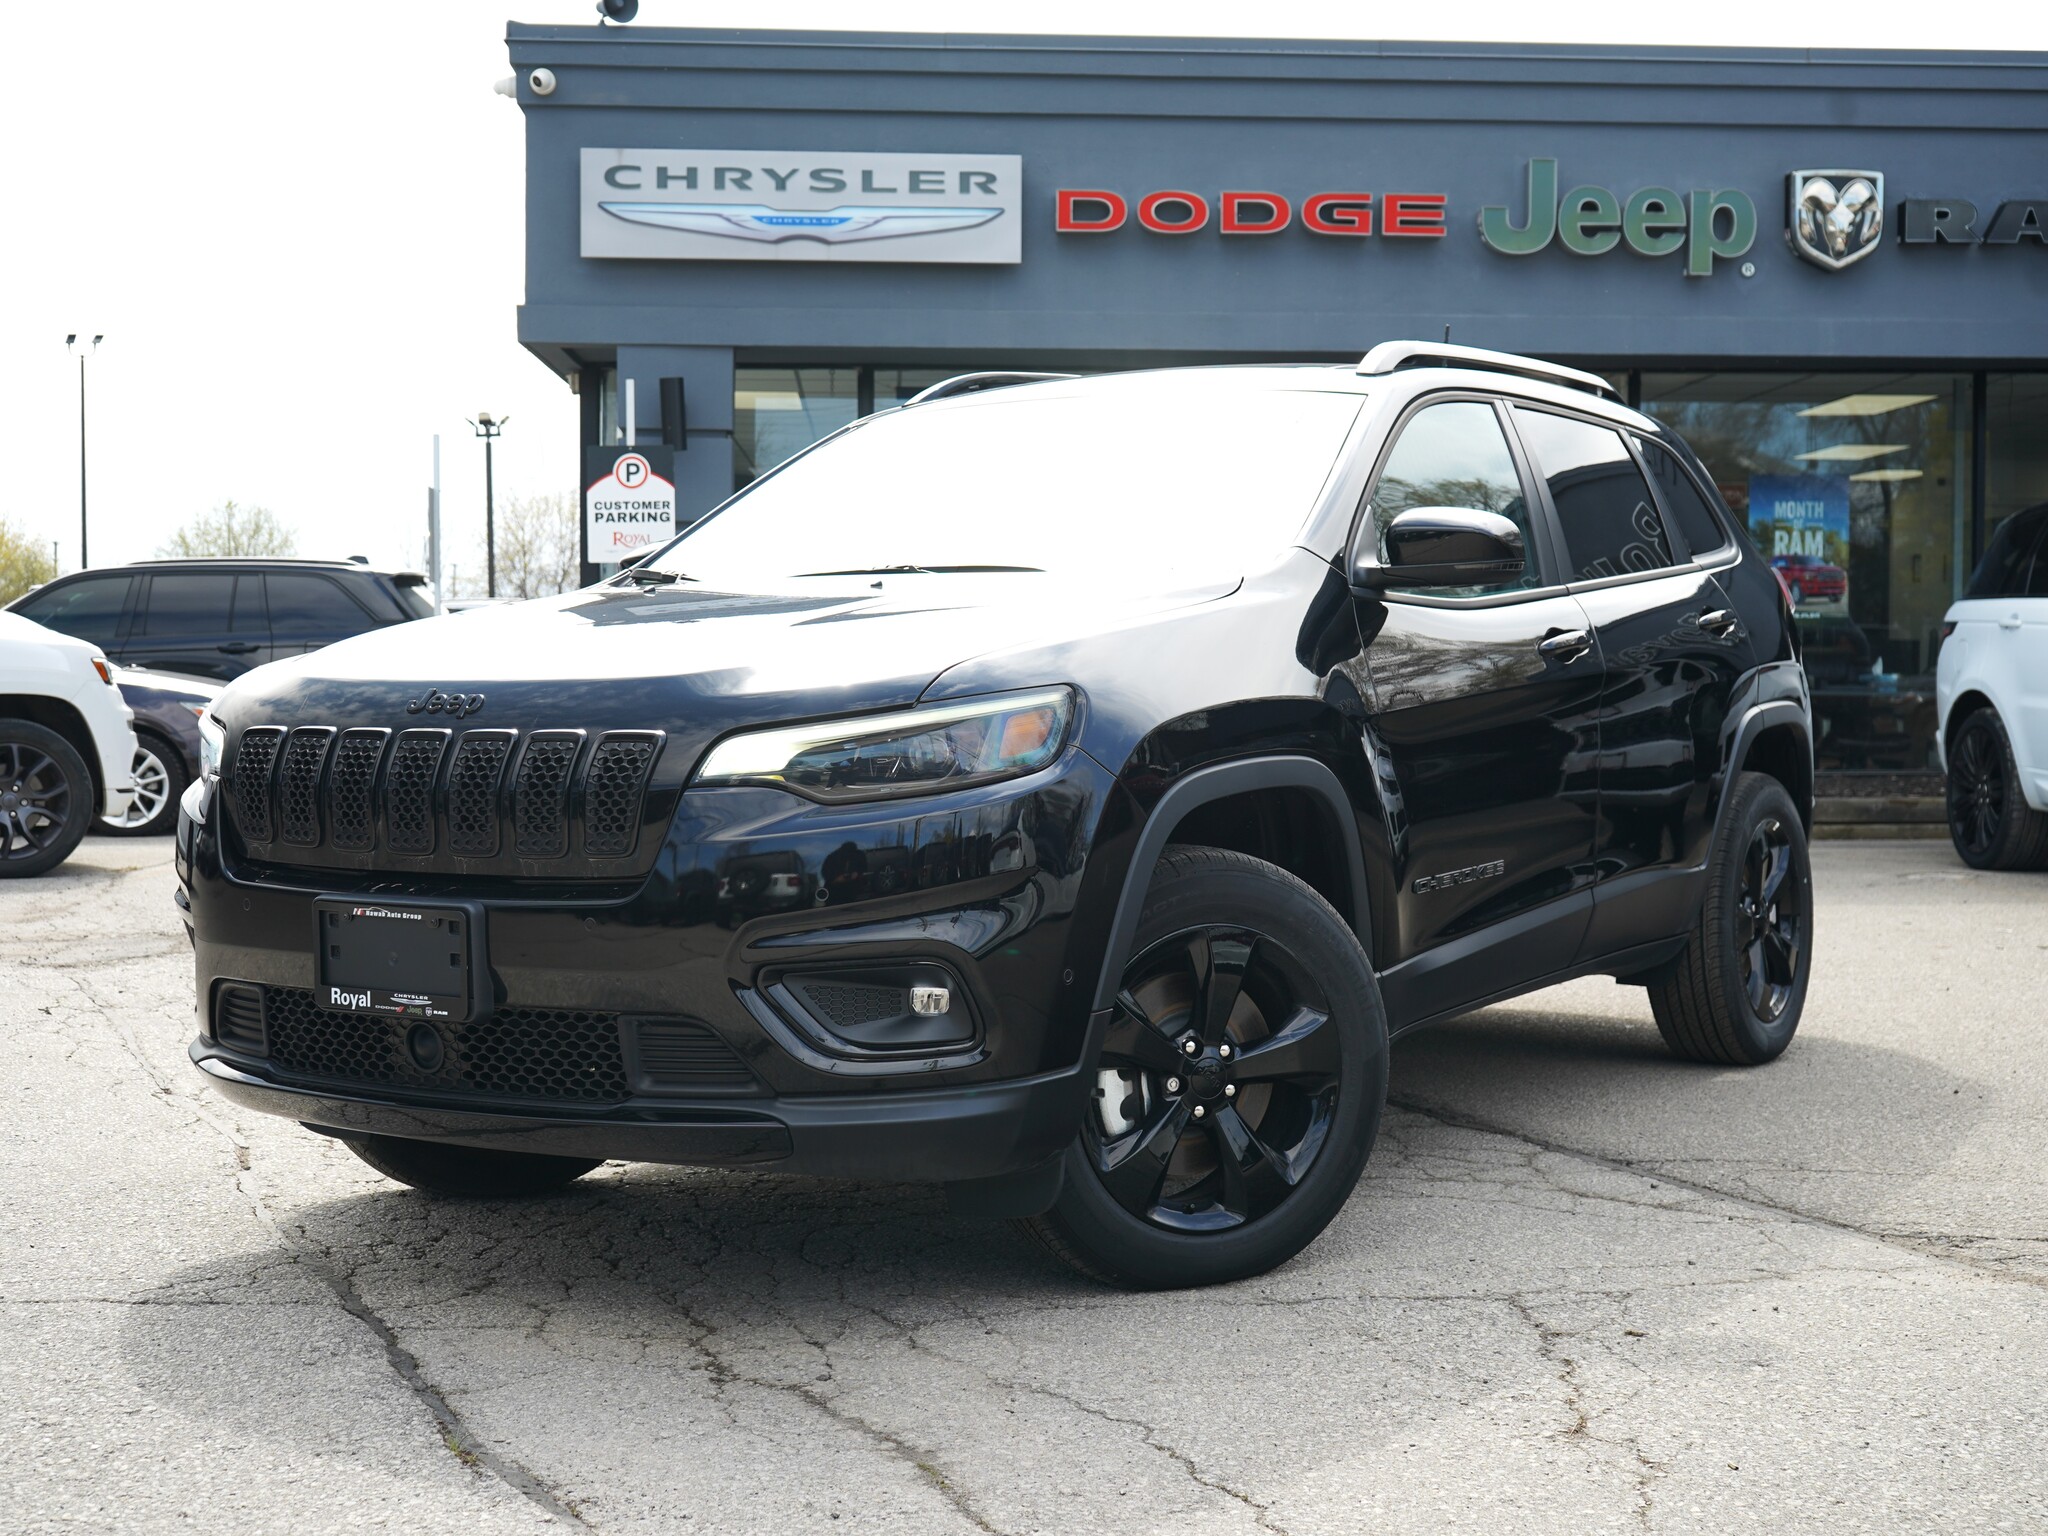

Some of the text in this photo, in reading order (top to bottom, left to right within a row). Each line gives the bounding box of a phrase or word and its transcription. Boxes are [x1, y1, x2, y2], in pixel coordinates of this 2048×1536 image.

[603, 164, 999, 195] CHRYSLER
[1055, 188, 1448, 237] DODGE
[1481, 157, 1757, 276] Jeep
[625, 463, 640, 482] P
[594, 501, 671, 511] CUSTOMER
[594, 511, 671, 523] PARKING
[1773, 500, 1825, 519] MONTH
[1773, 529, 1824, 558] RAM
[406, 687, 485, 720] Jeep
[1412, 859, 1505, 894] CHEROKEE
[386, 911, 401, 919] Auto
[402, 912, 422, 921] Group
[330, 987, 371, 1010] Royal
